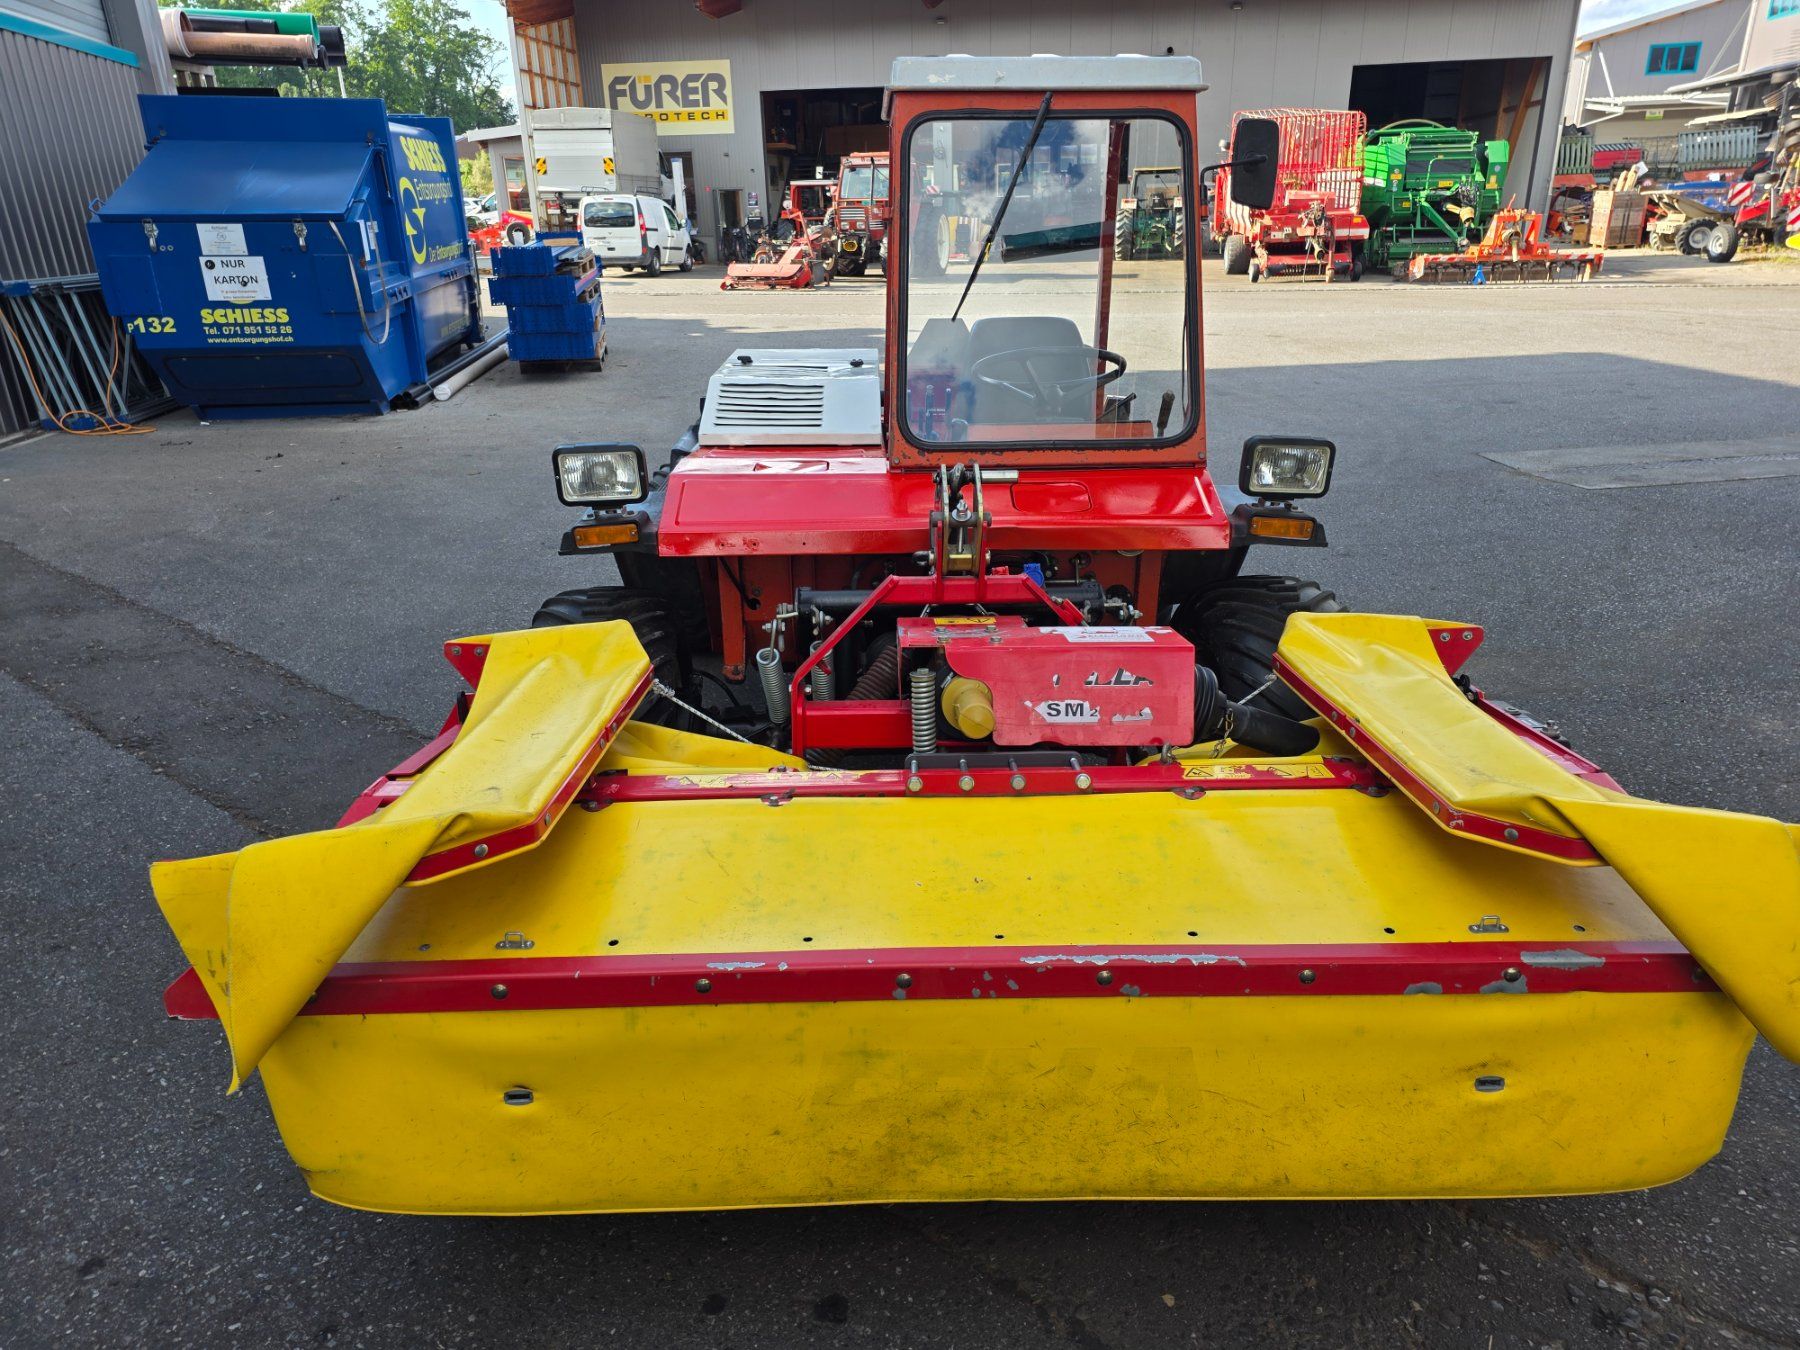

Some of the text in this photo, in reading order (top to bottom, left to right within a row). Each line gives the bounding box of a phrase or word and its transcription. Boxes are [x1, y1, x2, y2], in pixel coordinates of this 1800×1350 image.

[608, 73, 727, 109] FÜRER
[399, 135, 446, 171] SCHIESS
[220, 260, 245, 268] NUR
[213, 275, 258, 286] KARTON
[200, 308, 289, 323] SCHIESS
[203, 326, 221, 335] Tel.
[222, 326, 241, 335] 071
[264, 326, 278, 334] 52
[207, 336, 294, 344] www.entsorgungshof.ch
[1046, 702, 1084, 717] SM
